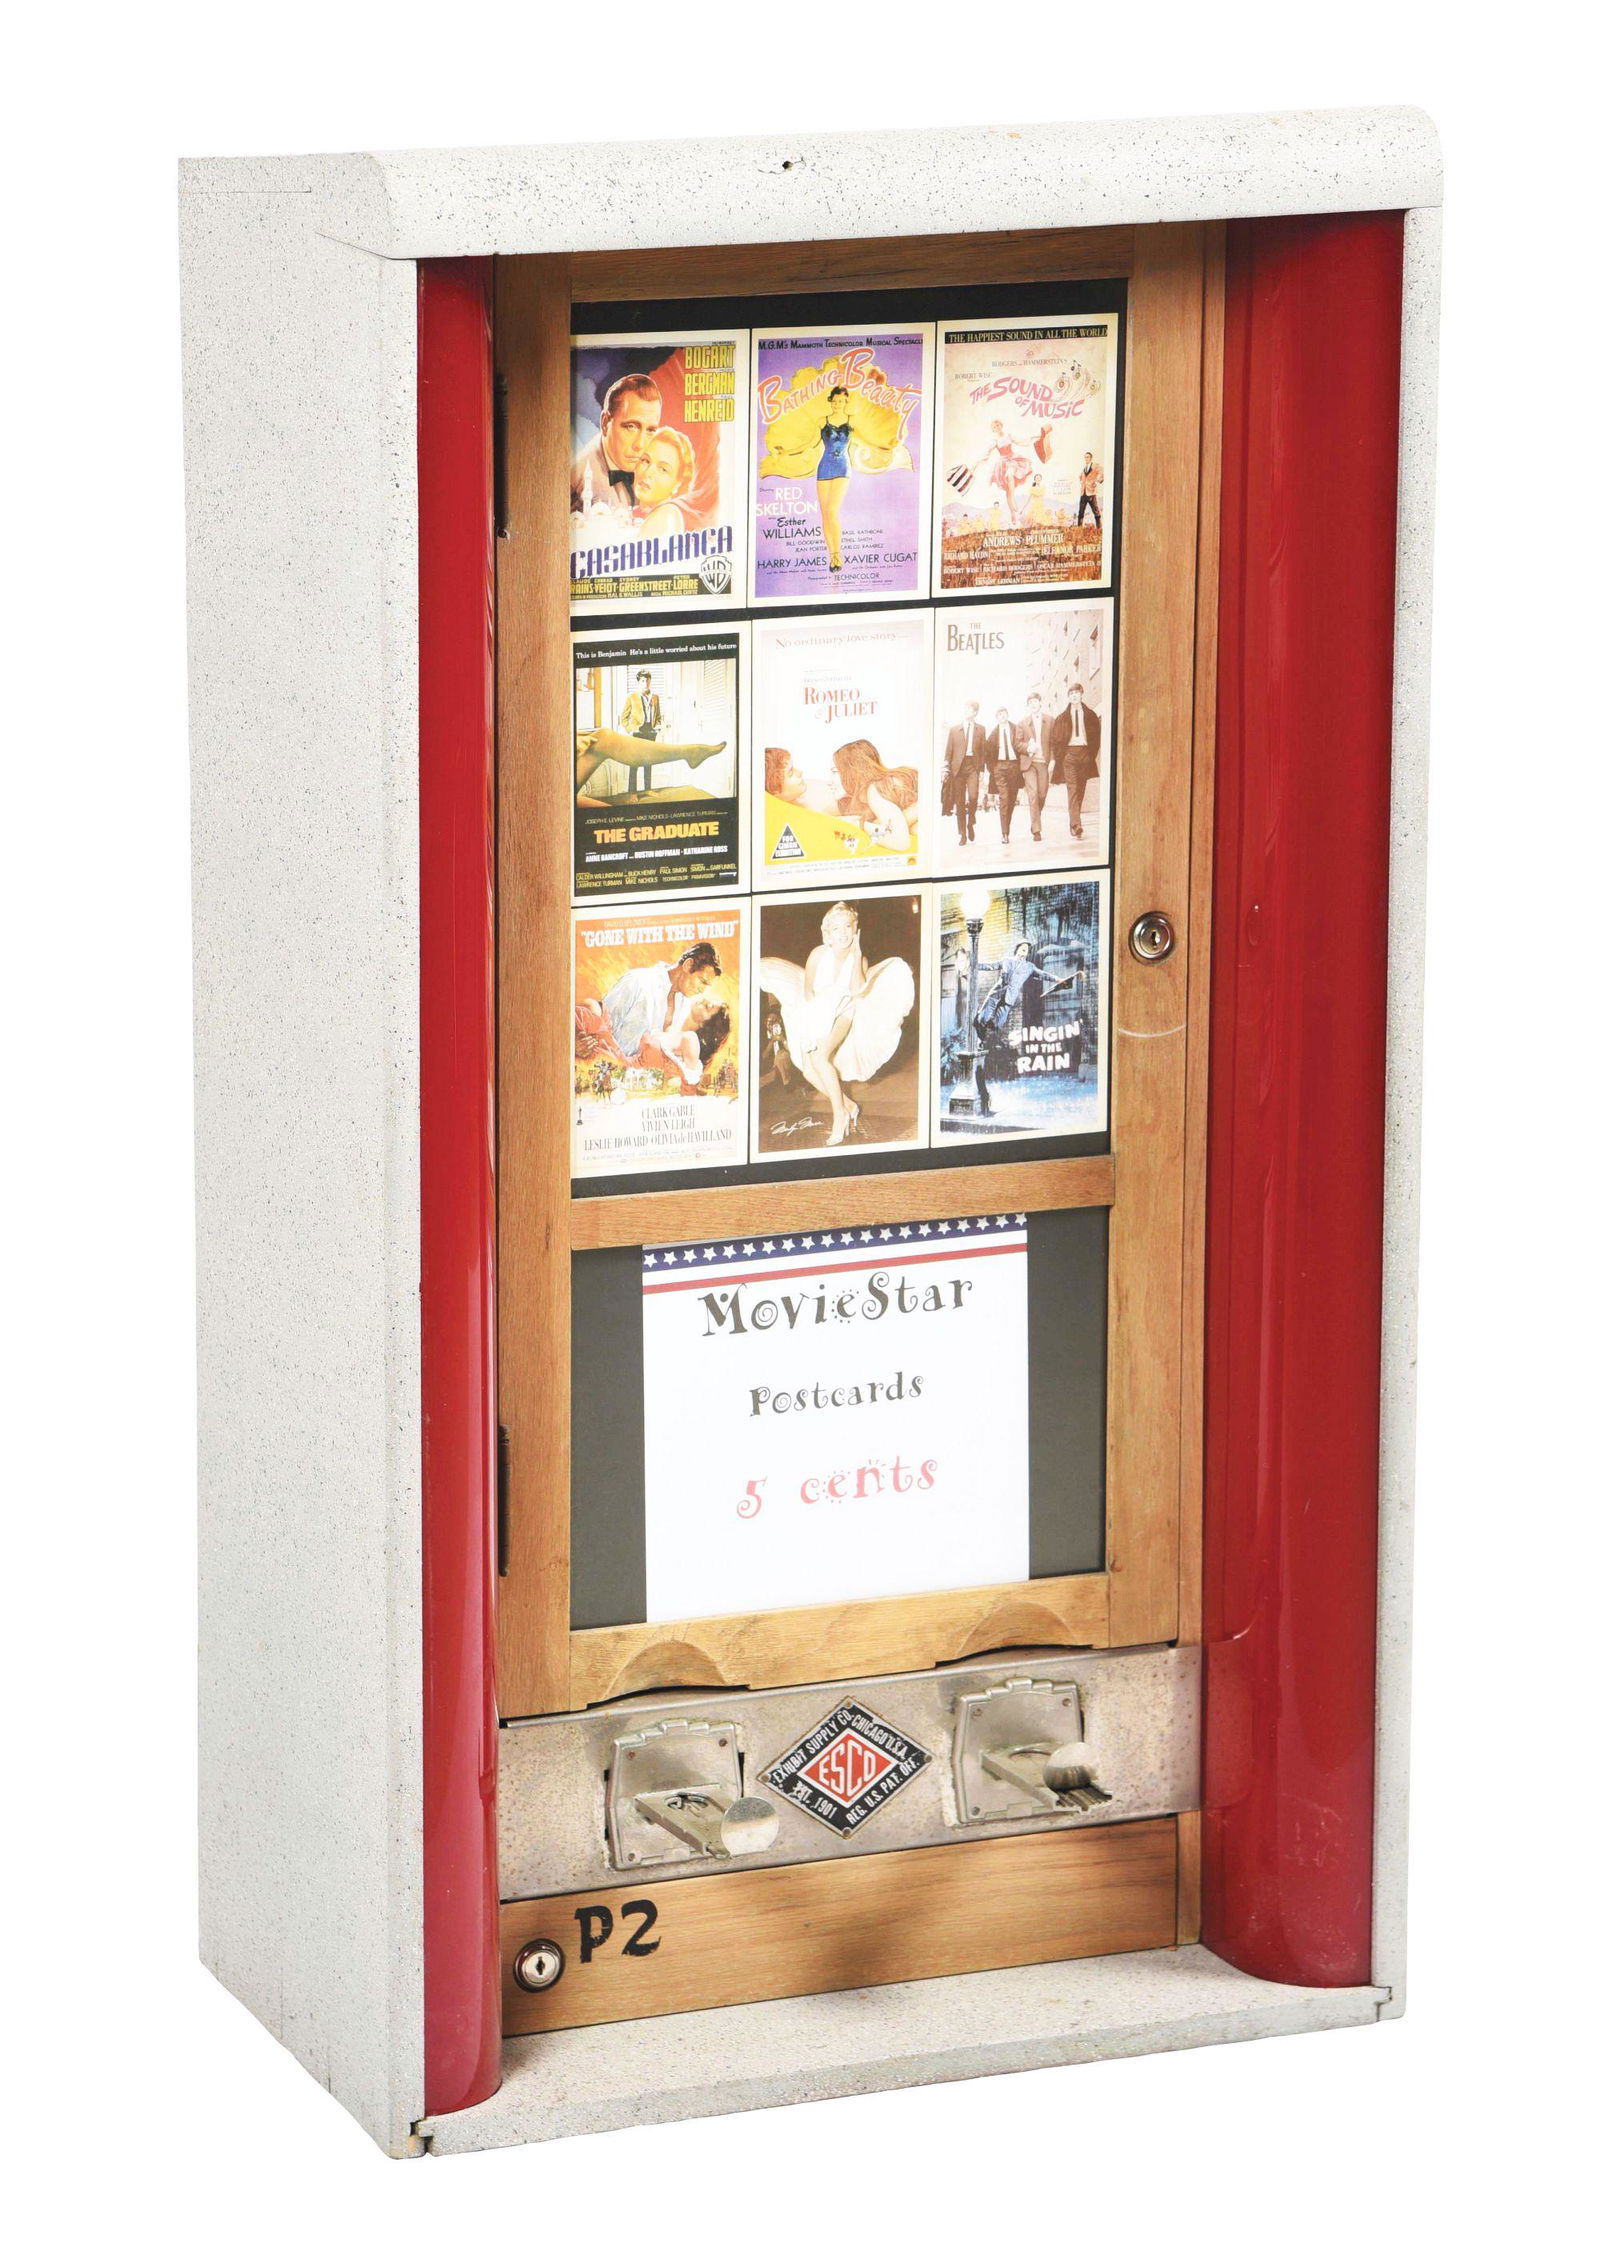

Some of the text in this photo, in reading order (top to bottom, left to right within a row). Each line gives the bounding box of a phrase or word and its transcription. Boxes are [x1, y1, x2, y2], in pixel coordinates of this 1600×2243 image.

[950, 334, 965, 343] THE
[967, 332, 1005, 342] HAPPIEST
[1006, 331, 1032, 341] SOUND
[1035, 330, 1043, 339] IN
[1045, 329, 1060, 338] ALL
[1062, 328, 1077, 338] THE
[685, 346, 736, 369] BOGART
[684, 372, 735, 396] BERGMAN
[840, 347, 923, 441] Beauty
[969, 376, 1053, 405] THE SOUND
[684, 399, 735, 423] HENREID
[1015, 396, 1028, 407] OF
[775, 487, 803, 501] RED
[756, 501, 818, 517] SKELTON
[777, 517, 806, 528] Esther
[763, 527, 821, 540] WILLIAMS
[570, 525, 733, 579] CASABLANCA
[844, 552, 918, 564] XAVIER CUGAT
[757, 557, 827, 569] HARRY JAMES
[834, 572, 880, 581] TECHNICOLOR
[970, 622, 981, 630] THE
[947, 624, 1005, 655] BEATLES
[598, 650, 627, 658] Benjamin
[629, 648, 643, 656] He's
[665, 645, 688, 653] worried
[689, 644, 706, 652] about
[804, 687, 861, 705] ROMEO
[825, 701, 879, 724] JULIET
[594, 821, 719, 844] THE GRADUATE
[626, 926, 664, 945] WITH
[665, 924, 695, 942] THE
[1008, 1018, 1083, 1046] SINGIN'
[1025, 1042, 1062, 1054] IN THE
[1017, 1053, 1070, 1074] RAIN
[641, 1104, 695, 1119] CLARK GABLE
[641, 1118, 695, 1132] VIVIEN LEIGH
[584, 1138, 613, 1151] LESLIE
[614, 1135, 648, 1149] HOWARD
[651, 1132, 677, 1145] OLIVIA
[697, 1271, 973, 1337] MovieStar
[736, 1455, 938, 1519] 5 cents
[851, 1714, 889, 1745] CHICAGO
[772, 1748, 807, 1783] EXHIBIT
[805, 1720, 839, 1754] SUPPLY
[818, 1738, 877, 1797] ESCO
[845, 1757, 920, 1825] REG. U.S. PAT. OFF.
[814, 1797, 838, 1819] 1901
[574, 1899, 662, 1964] P2
